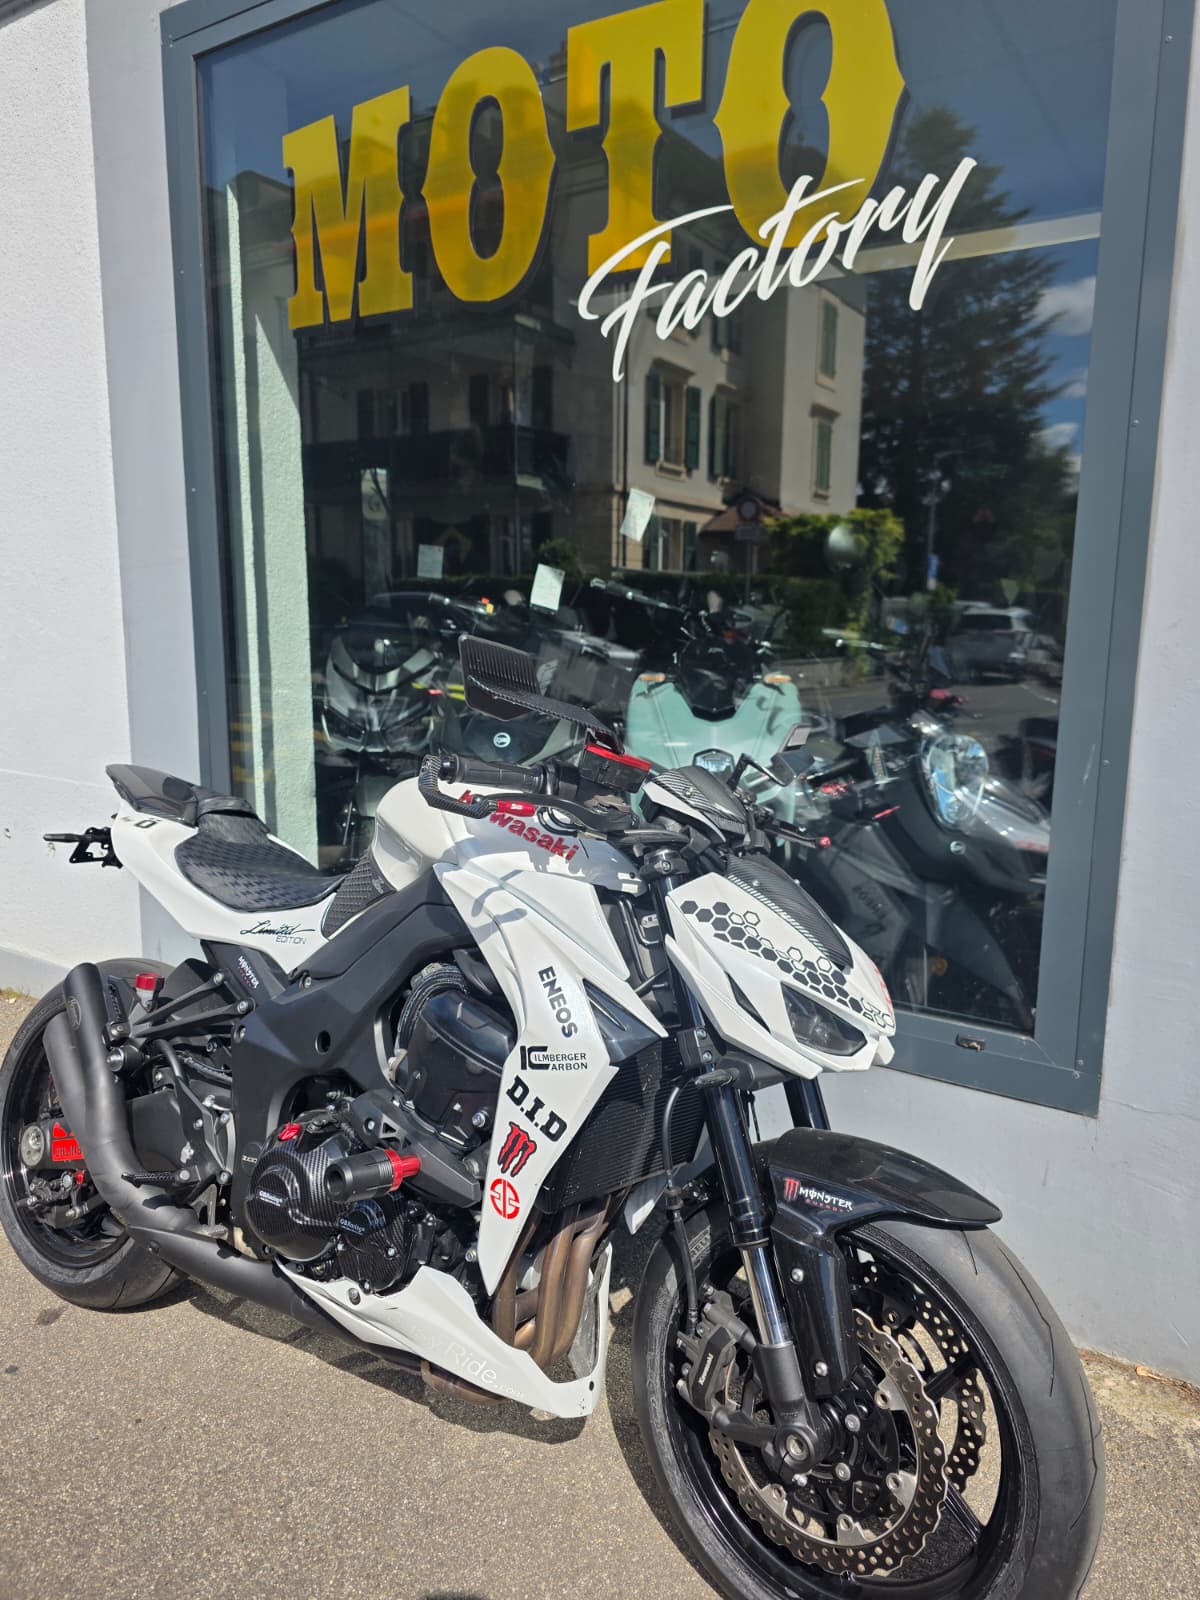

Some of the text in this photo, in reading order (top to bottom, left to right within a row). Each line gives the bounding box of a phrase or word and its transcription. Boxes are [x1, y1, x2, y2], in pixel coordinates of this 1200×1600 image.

[281, 0, 907, 331] MOTO
[578, 157, 978, 382] Factory
[538, 966, 578, 1038] ENEOS
[506, 1075, 568, 1142] D.I.D
[799, 1185, 853, 1212] MONSTER
